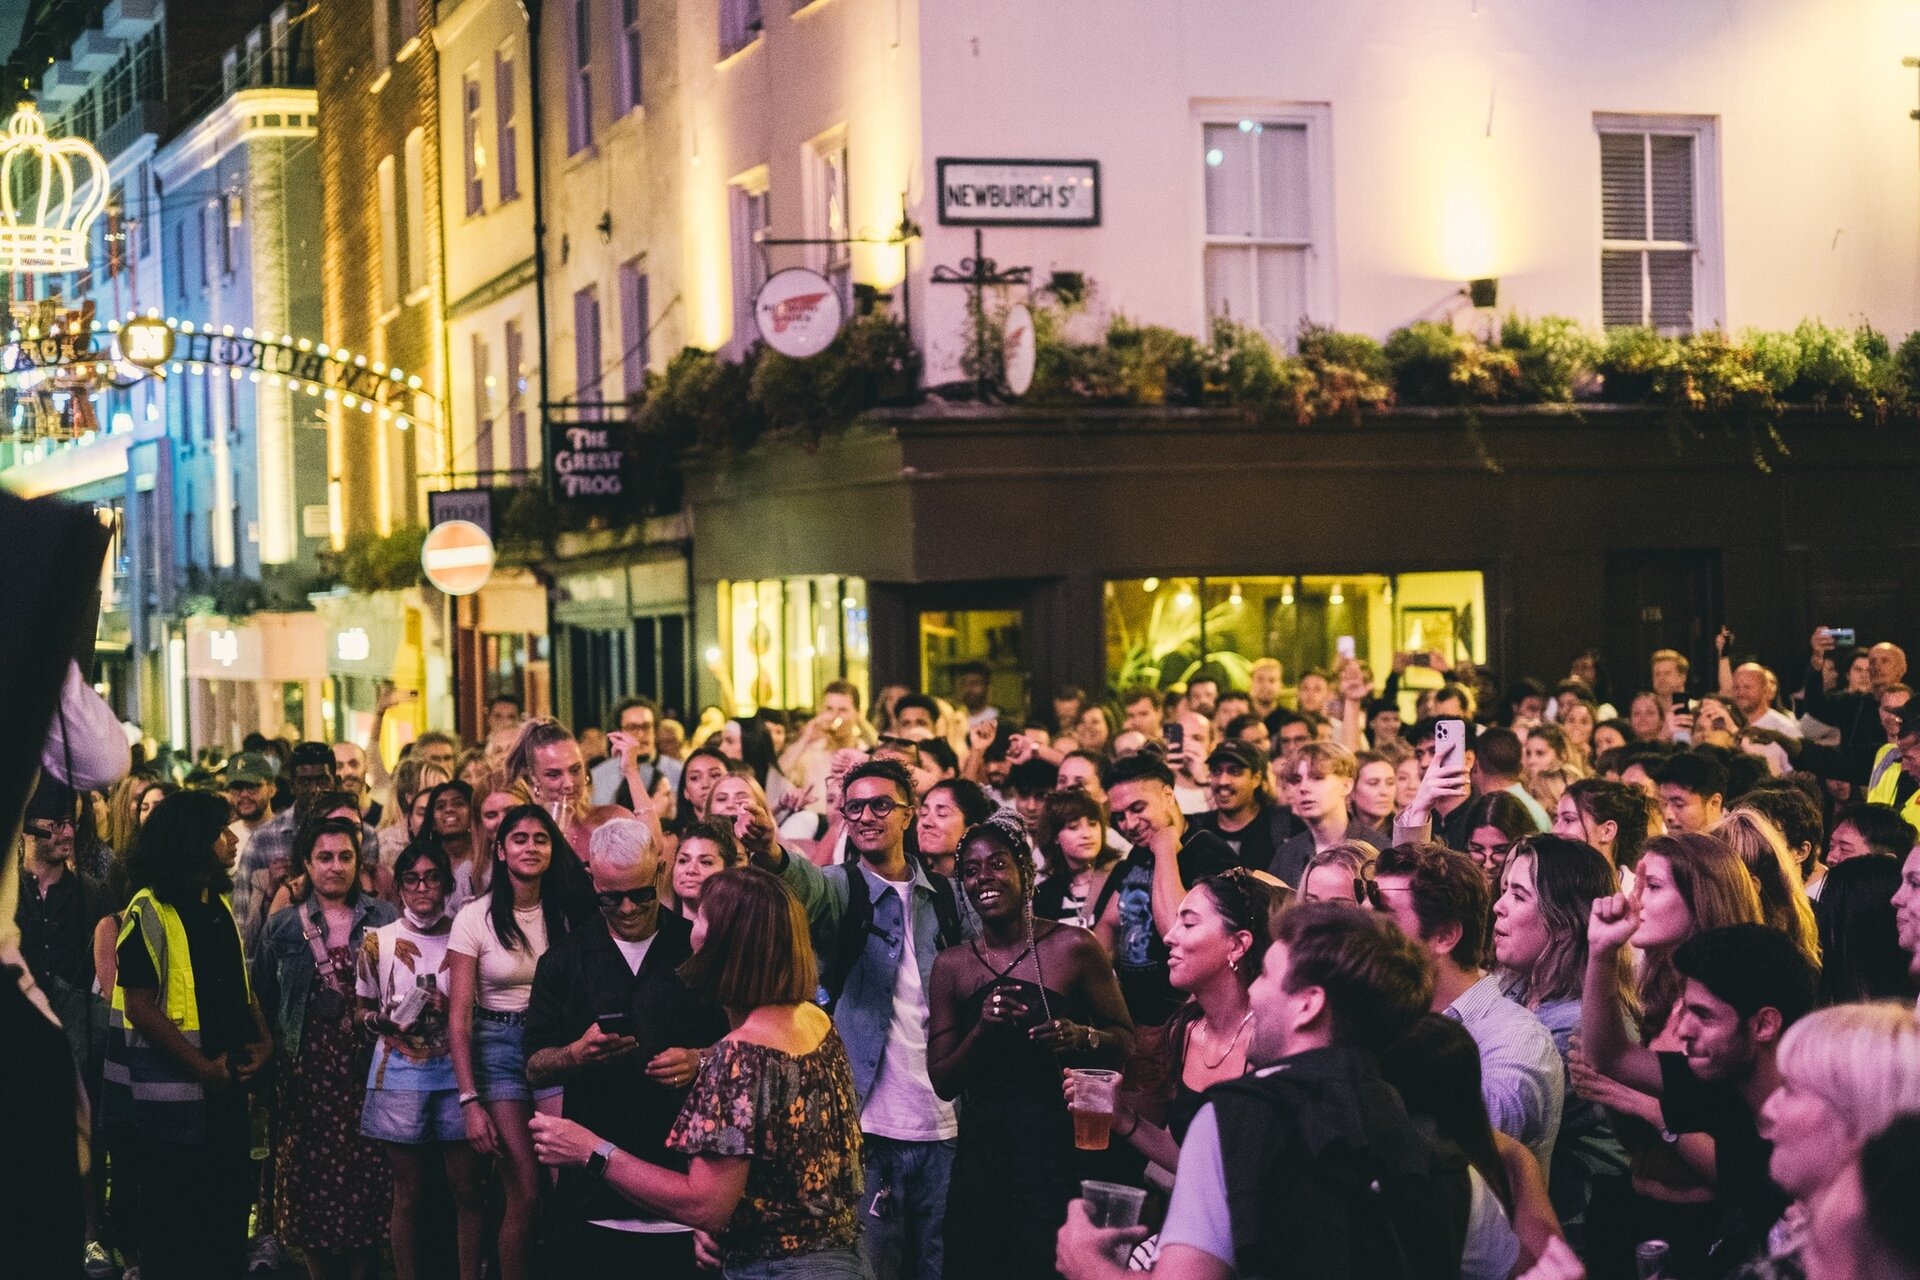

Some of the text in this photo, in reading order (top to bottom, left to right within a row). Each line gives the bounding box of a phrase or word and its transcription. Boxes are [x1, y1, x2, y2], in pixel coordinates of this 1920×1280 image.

[946, 184, 1053, 207] NEWBURGH
[565, 426, 608, 450] THE
[554, 450, 623, 475] GREAT
